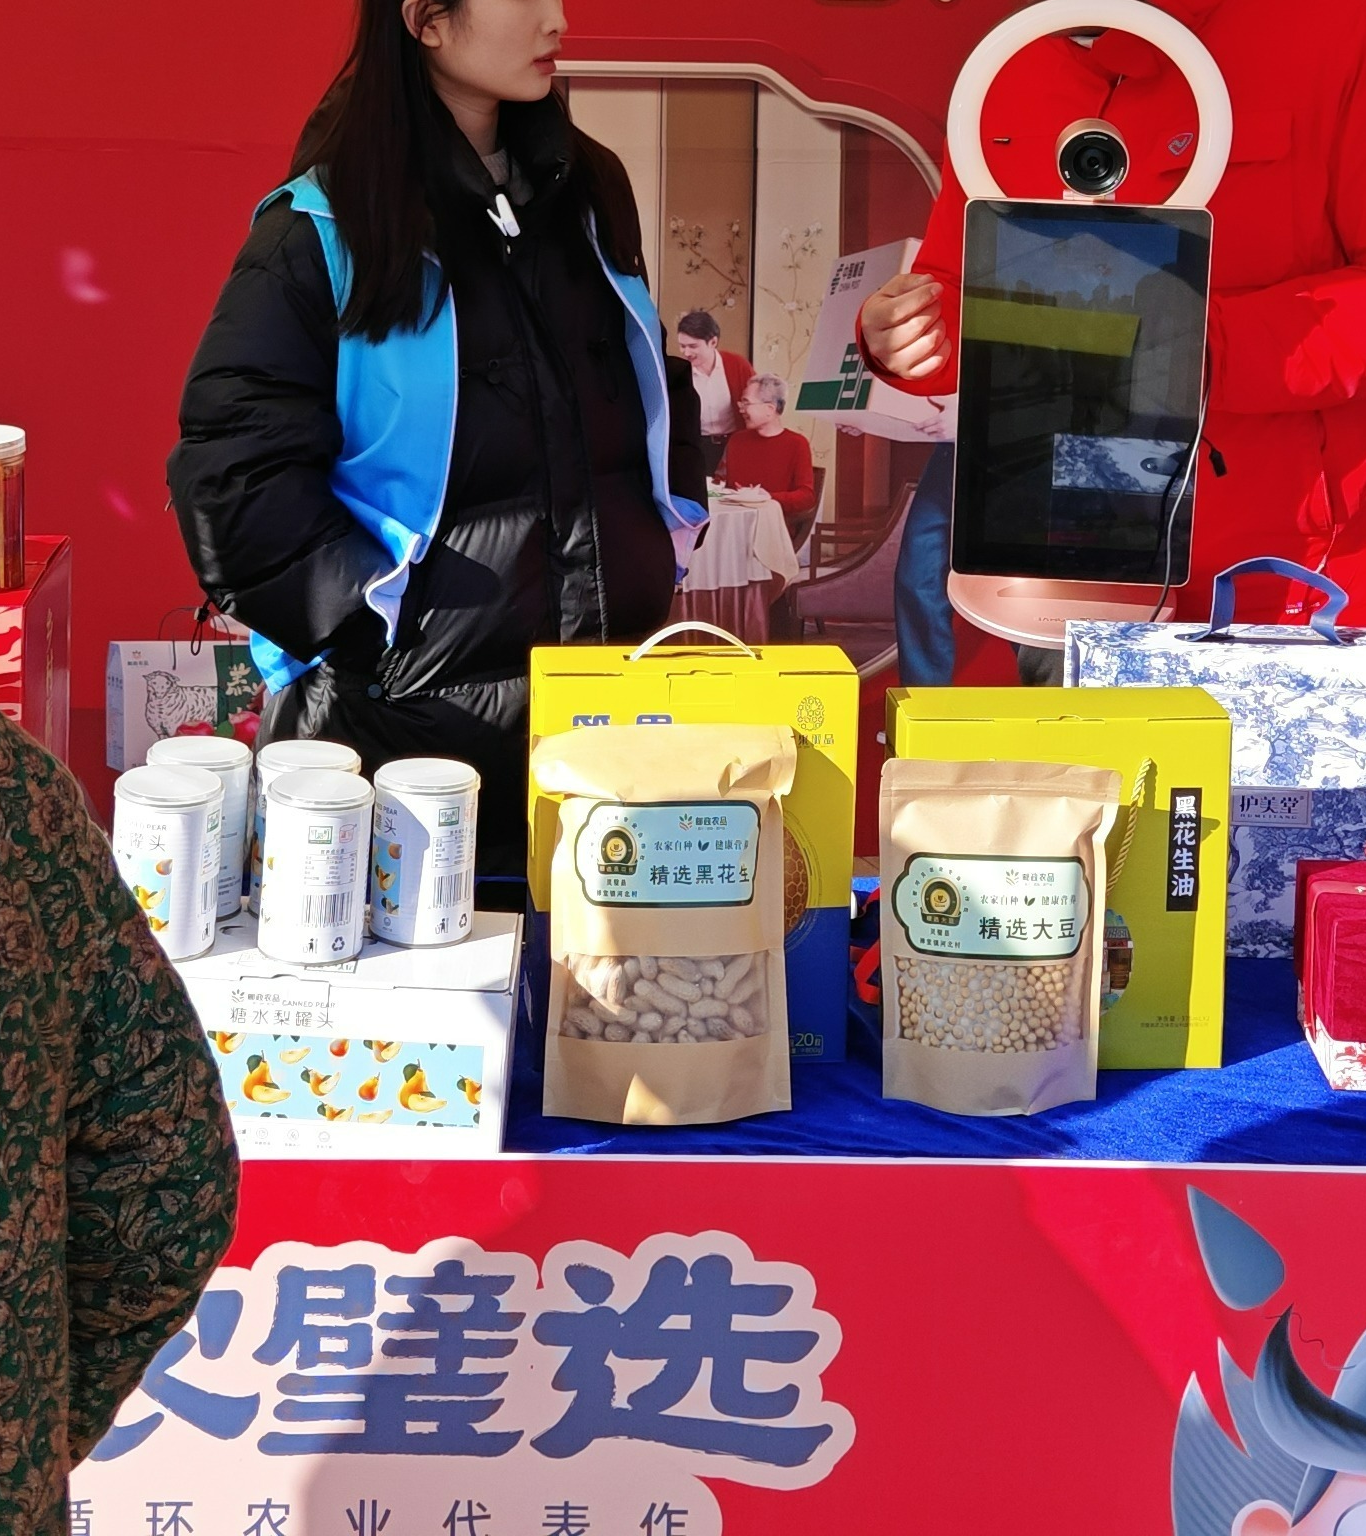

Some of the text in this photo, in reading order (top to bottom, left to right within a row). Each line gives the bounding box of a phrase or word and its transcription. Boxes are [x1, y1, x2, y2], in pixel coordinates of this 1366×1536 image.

[1239, 795, 1300, 814] 护美堂
[1170, 795, 1197, 898] 黑花生油
[649, 863, 751, 886] 精选黑花生
[978, 916, 1077, 941] 精选大豆
[229, 1007, 334, 1029] 糖水梨罐头
